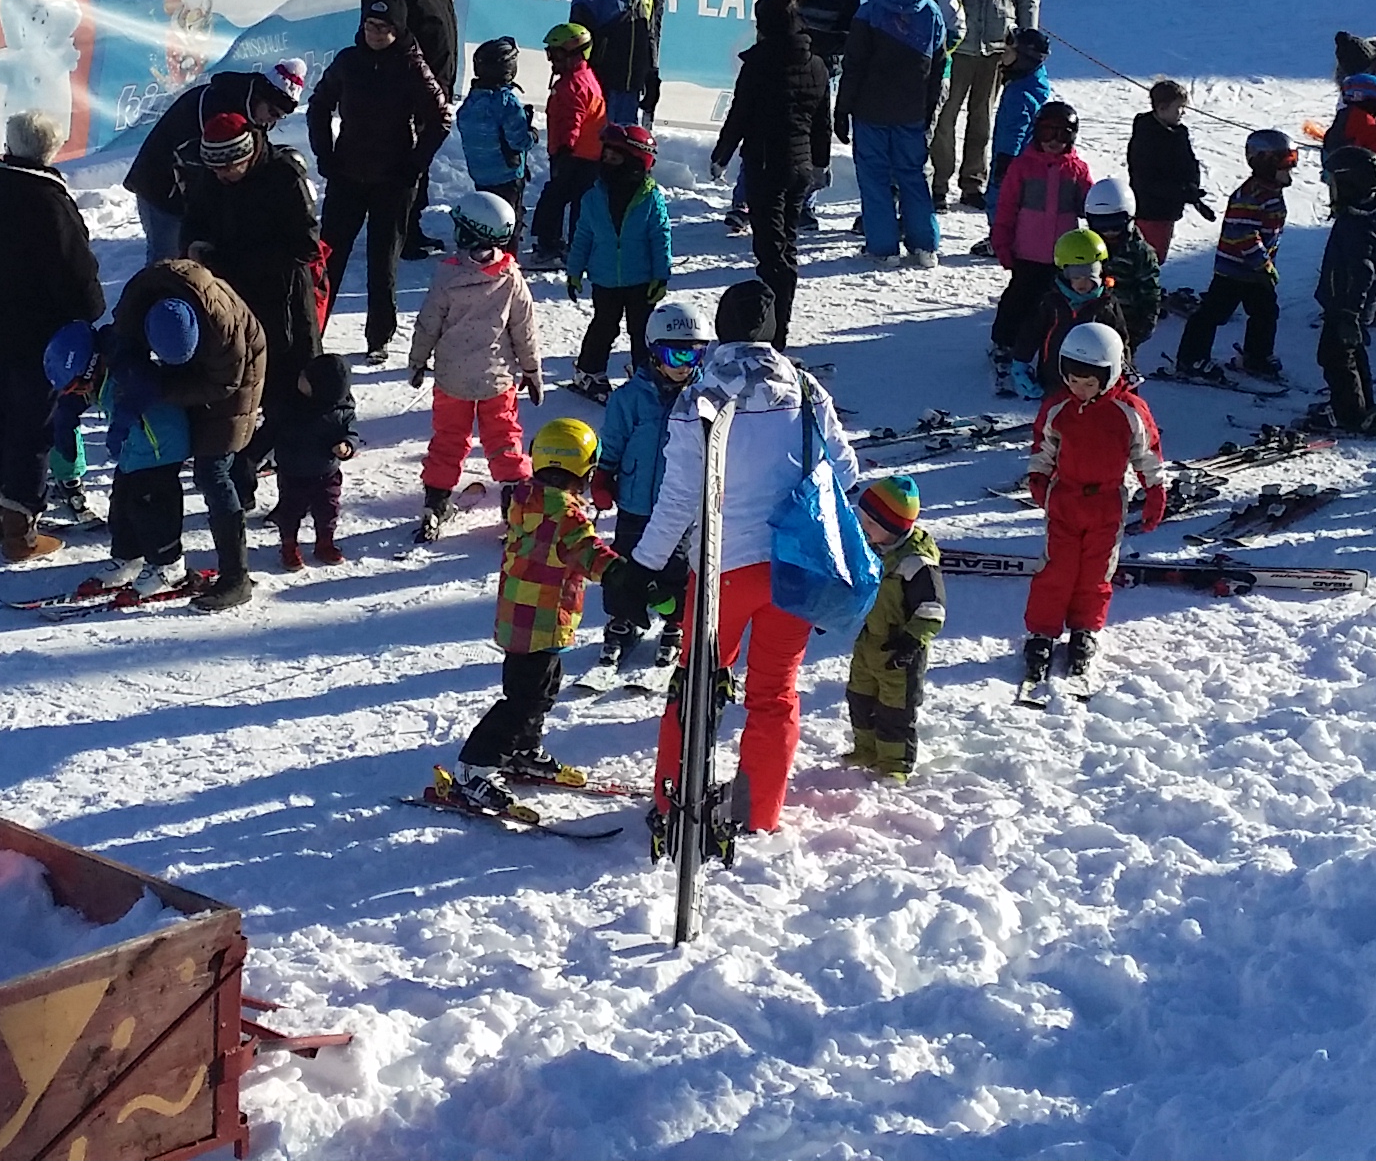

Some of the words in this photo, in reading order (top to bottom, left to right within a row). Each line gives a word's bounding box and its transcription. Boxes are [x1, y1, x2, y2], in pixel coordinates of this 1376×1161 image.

[83, 352, 100, 379] uvex
[939, 557, 1024, 574] HEAD
[1312, 580, 1354, 588] HEAD
